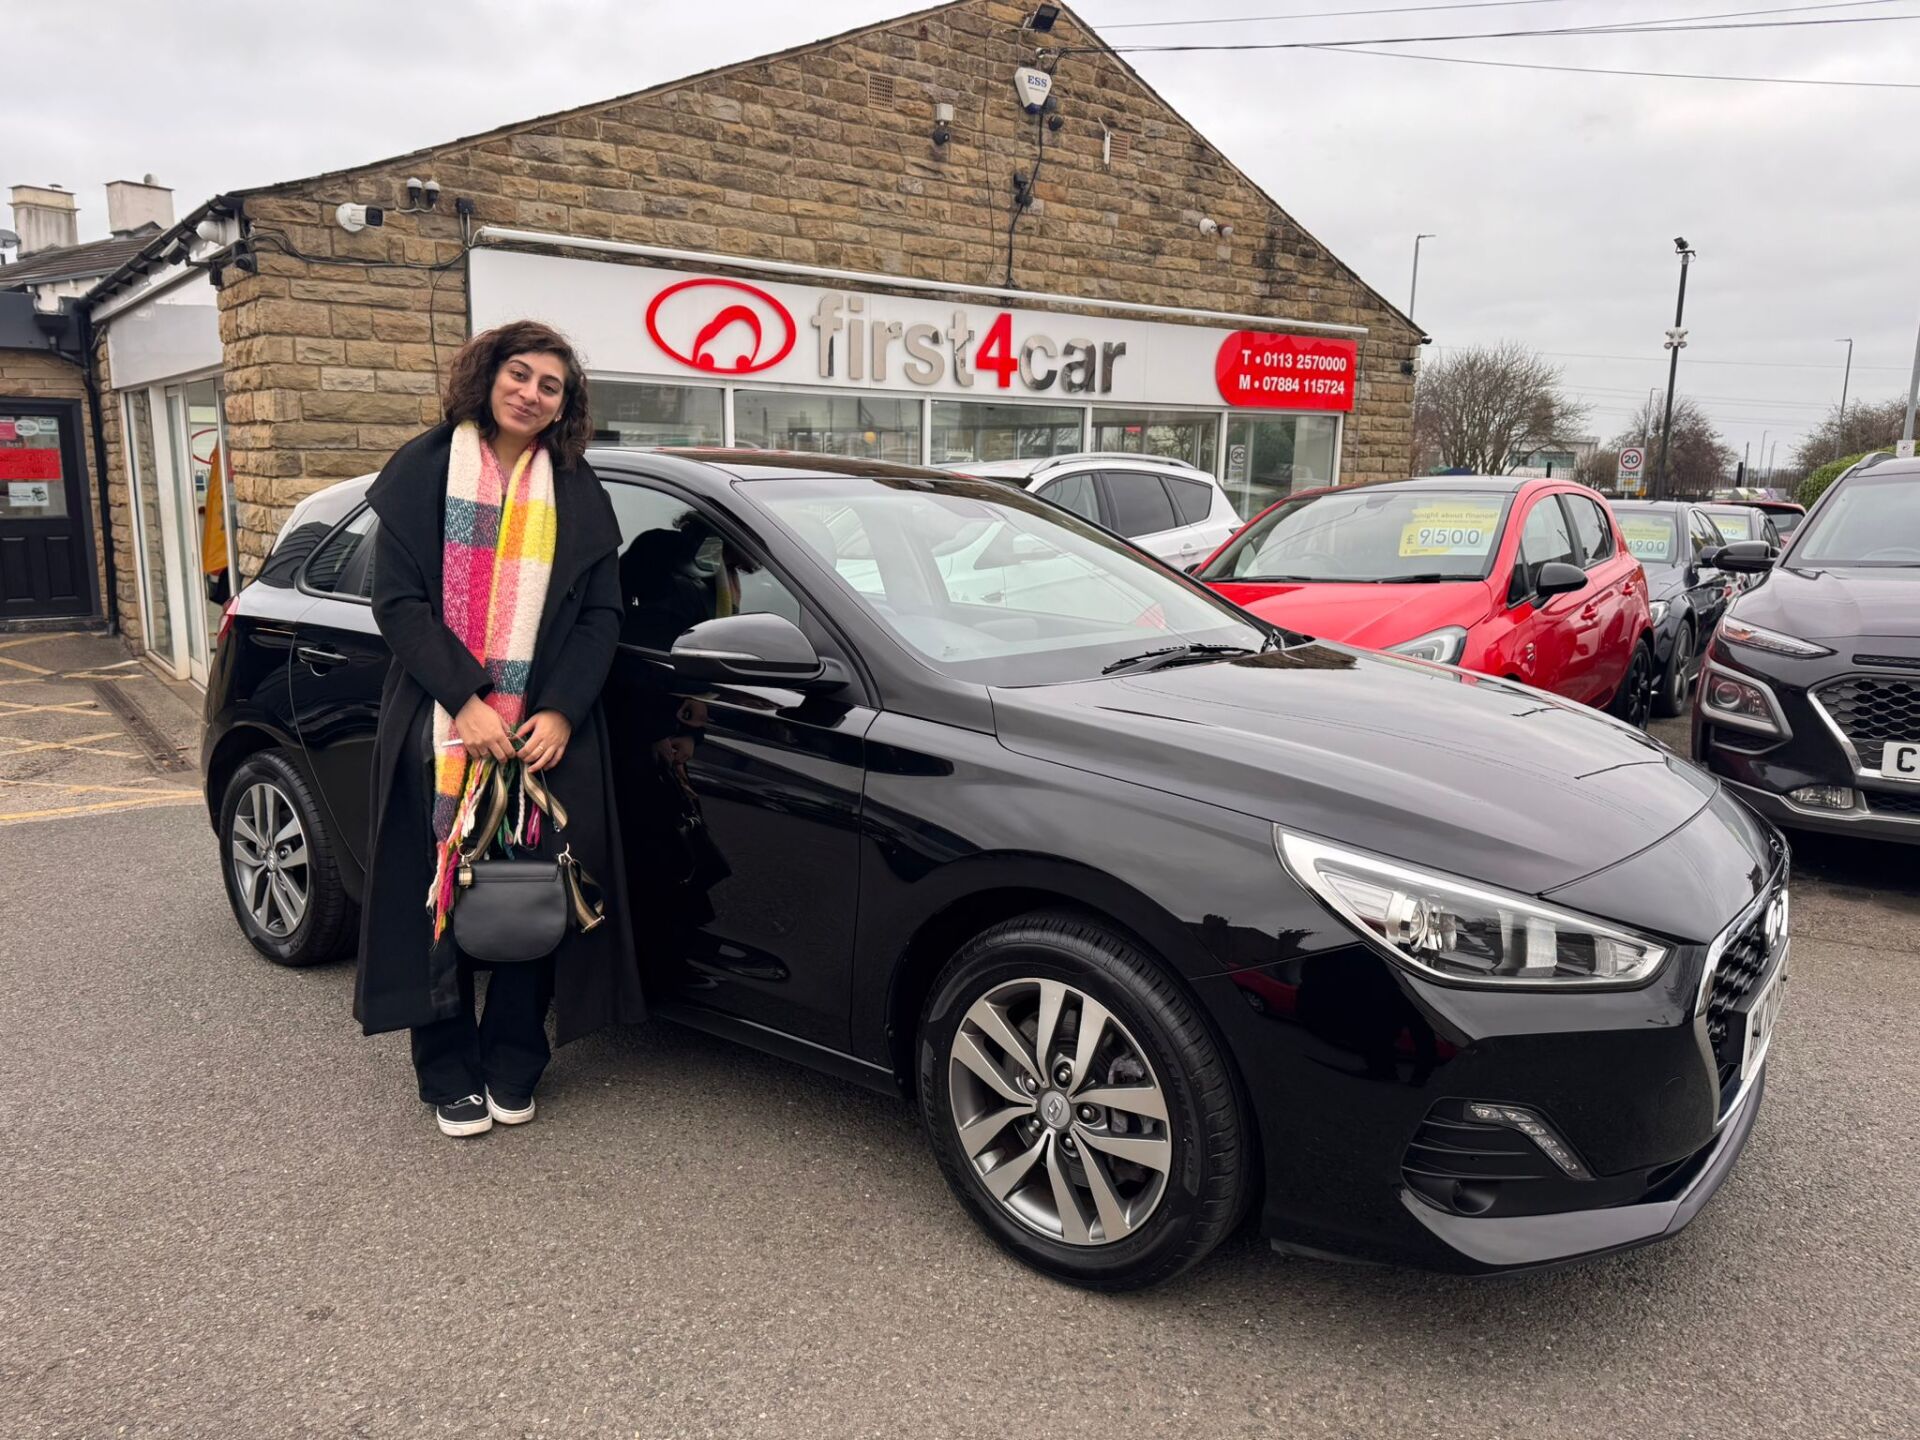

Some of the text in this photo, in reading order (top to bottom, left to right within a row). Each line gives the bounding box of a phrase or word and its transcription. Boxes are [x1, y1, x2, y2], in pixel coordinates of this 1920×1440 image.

[1028, 75, 1047, 87] ESS
[811, 292, 1127, 395] first4car
[1242, 350, 1346, 371] T 0113 2570000
[1239, 375, 1344, 394] M 07884 115724
[1624, 454, 1639, 464] 20
[1419, 528, 1480, 545] 9500
